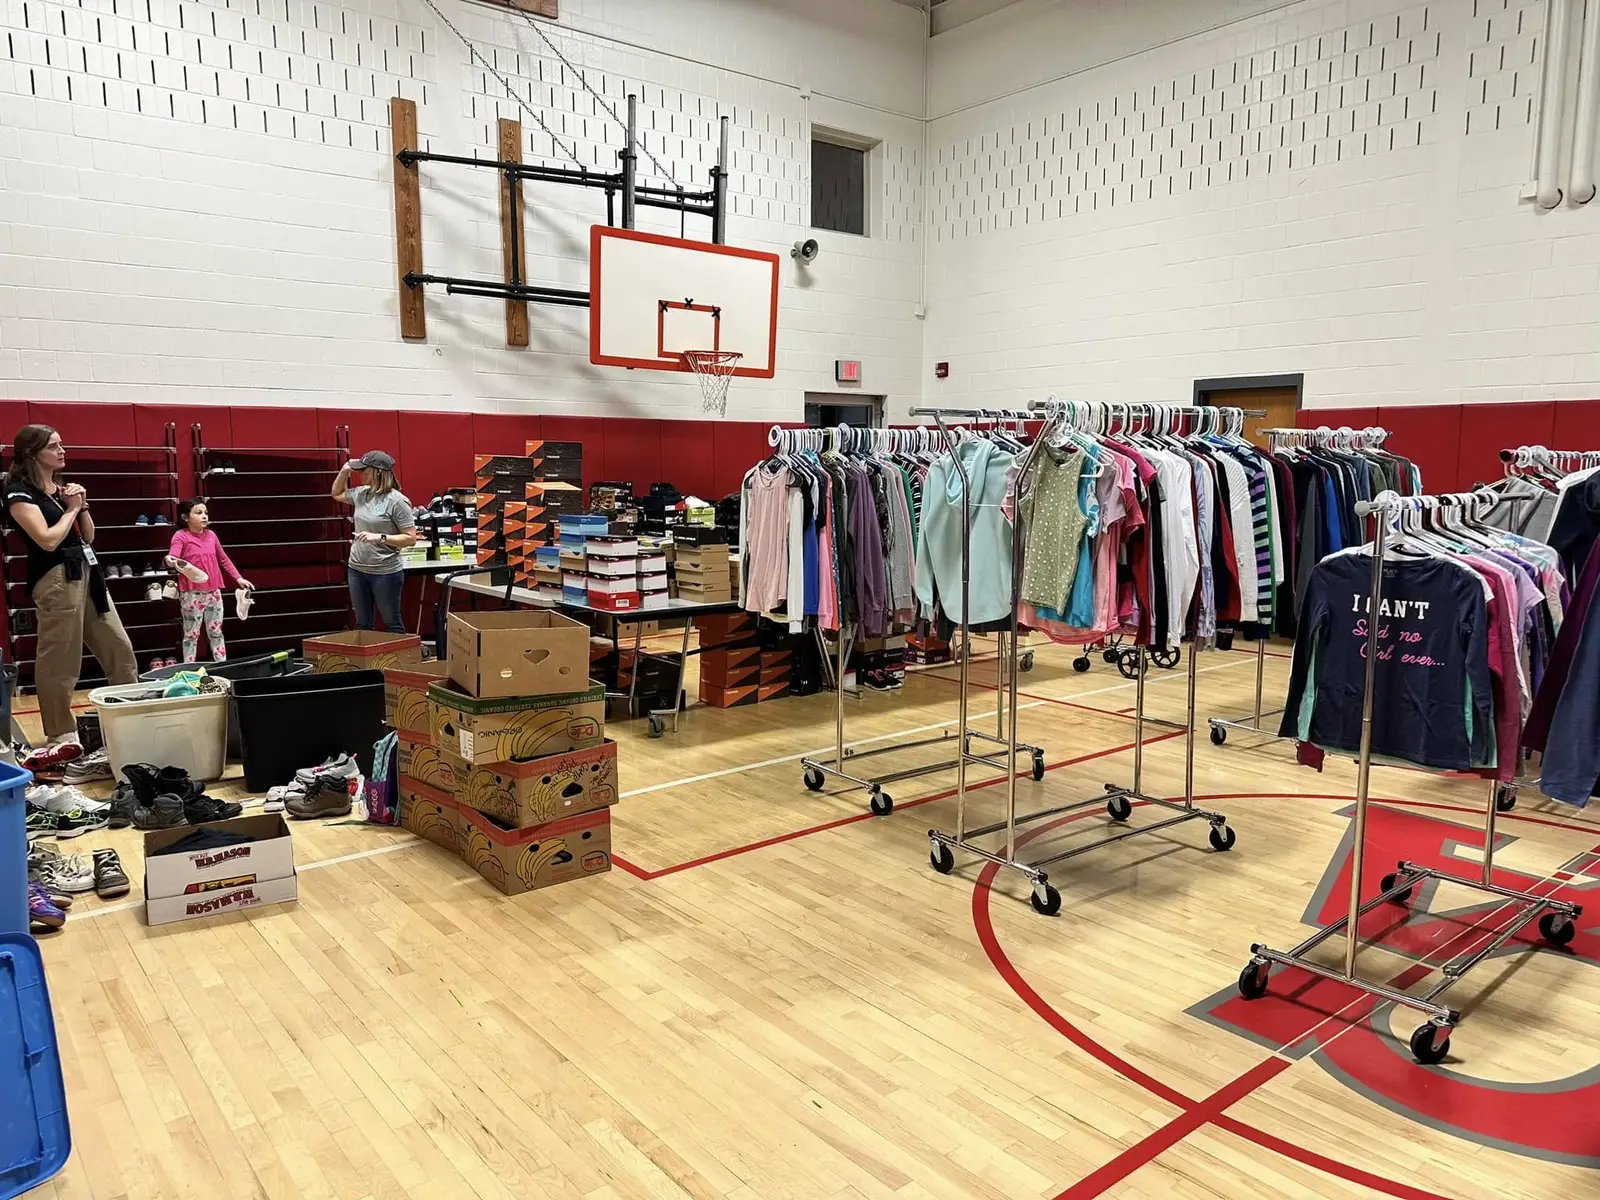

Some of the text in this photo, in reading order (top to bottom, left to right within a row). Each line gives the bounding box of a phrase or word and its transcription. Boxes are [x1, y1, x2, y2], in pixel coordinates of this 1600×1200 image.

[1352, 593, 1360, 612] I
[1352, 619, 1422, 643] Sd no
[1401, 653, 1445, 666] ever...
[478, 726, 523, 739] ORGANIC
[571, 725, 594, 737] Dole
